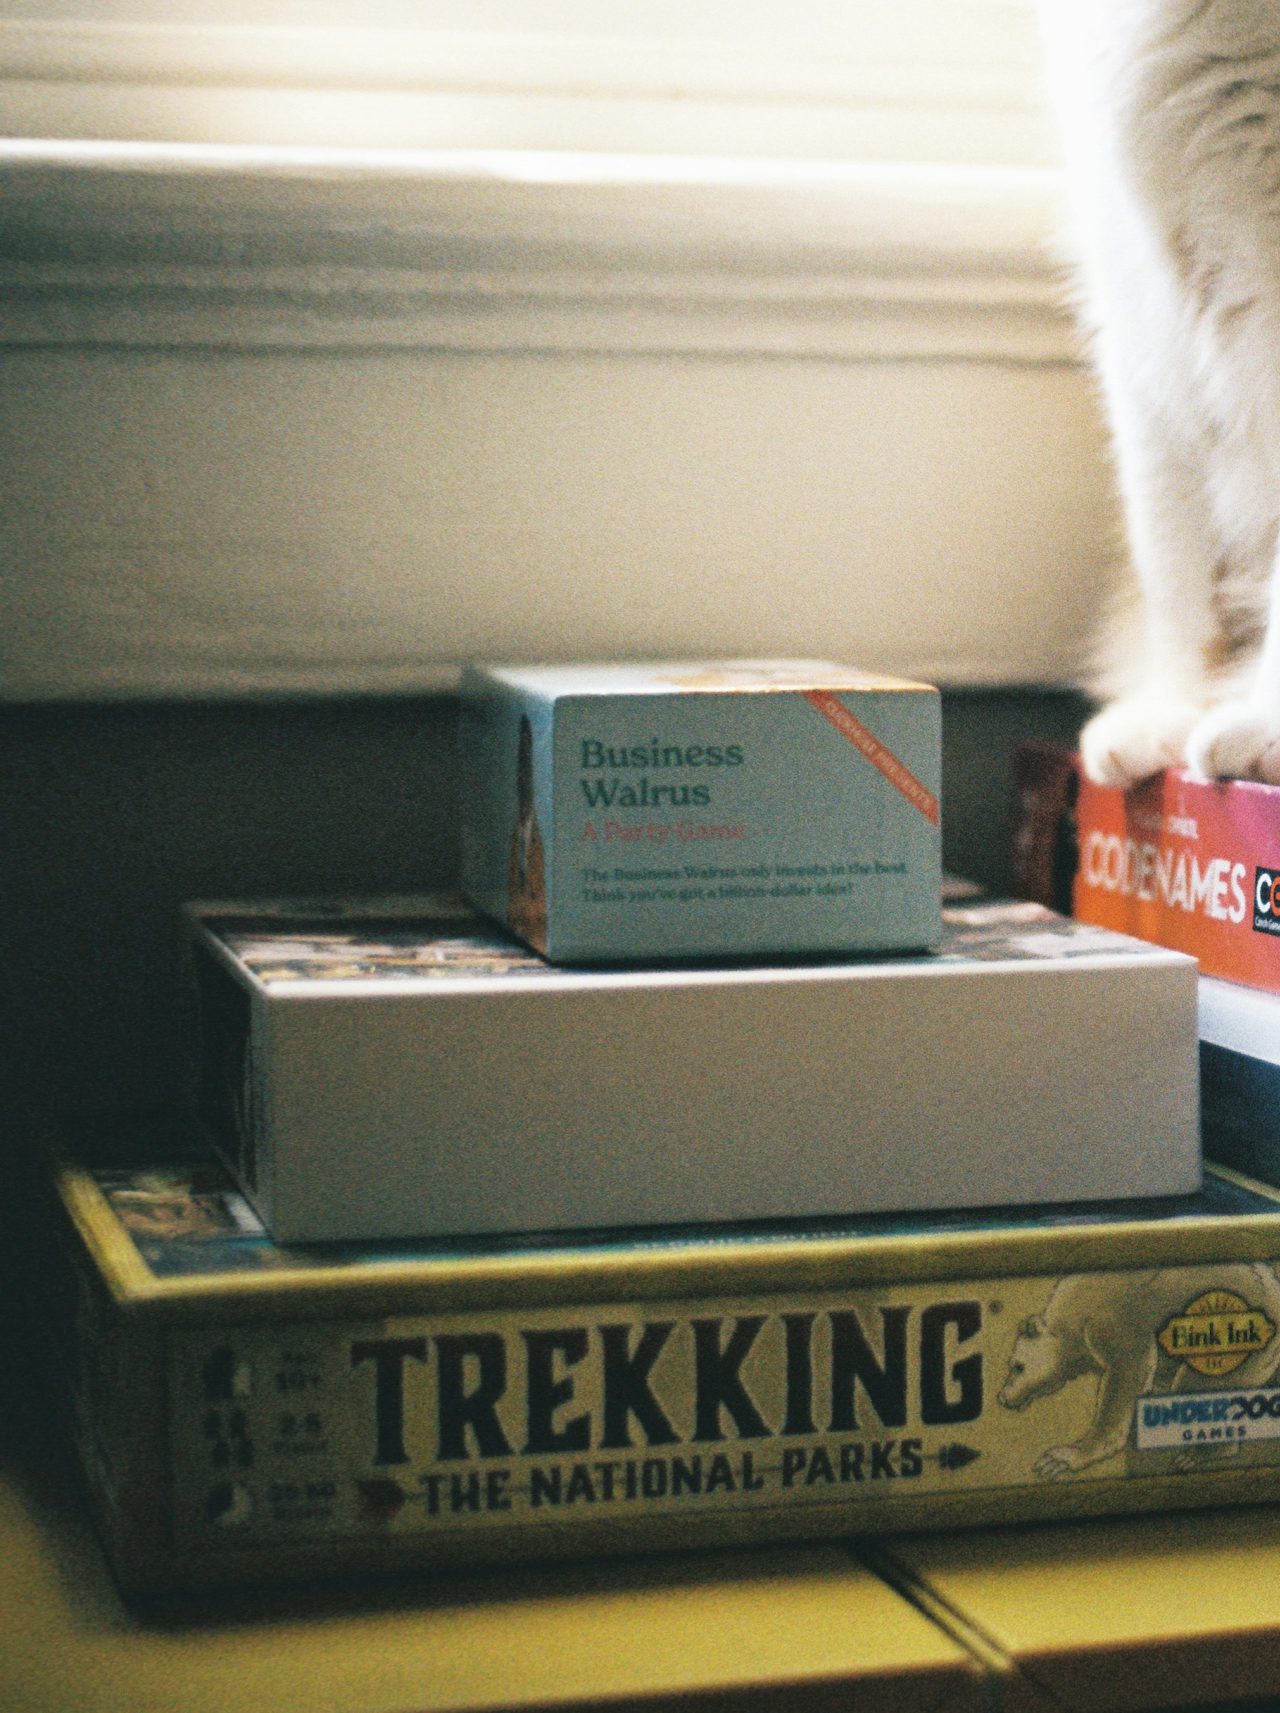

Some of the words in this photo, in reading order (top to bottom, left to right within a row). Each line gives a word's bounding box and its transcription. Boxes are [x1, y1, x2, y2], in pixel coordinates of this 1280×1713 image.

[582, 737, 745, 769] Business
[580, 777, 712, 808] Walrus
[580, 821, 598, 841] A
[604, 820, 670, 845] Party
[675, 818, 746, 842] Game
[1085, 831, 1248, 924] CODENAMES
[1171, 1323, 1223, 1349] Bink
[1227, 1320, 1263, 1345] Ink
[350, 1301, 983, 1467] TREKKING
[1181, 1425, 1248, 1442] GAMES
[421, 1469, 513, 1516] THE
[529, 1447, 764, 1509] NATIONAL
[781, 1438, 923, 1488] PARKS
